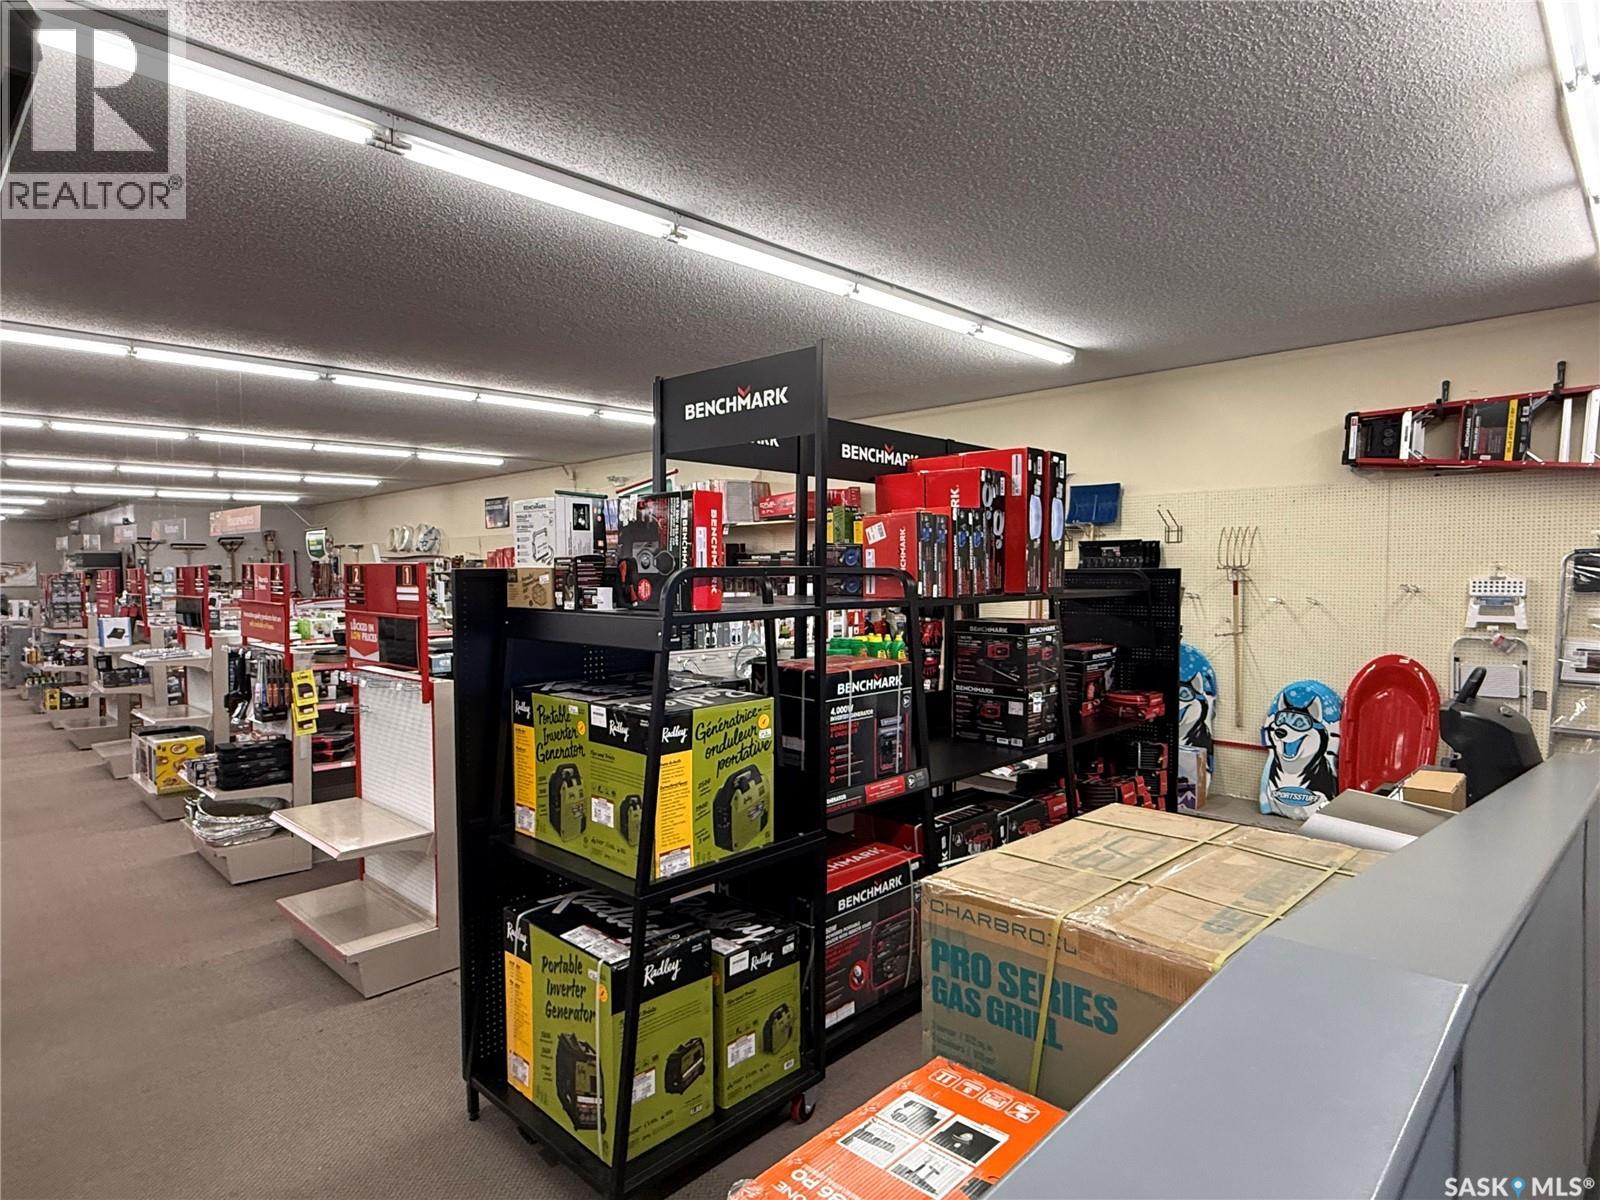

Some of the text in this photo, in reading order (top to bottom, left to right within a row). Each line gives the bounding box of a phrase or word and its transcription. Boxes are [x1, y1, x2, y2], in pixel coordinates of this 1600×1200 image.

[684, 385, 789, 421] BENCHMARK
[841, 443, 919, 467] BENCHMAR
[710, 508, 718, 594] BENCHMRK
[837, 674, 903, 696] BENCHMARK
[514, 699, 531, 720] Radley
[536, 704, 572, 725] Portable
[542, 725, 578, 746] Inverter
[608, 717, 630, 743] Radley
[661, 726, 689, 744] Radley
[704, 724, 758, 760] onduleur
[536, 741, 586, 765] Generator
[716, 738, 773, 778] portative
[837, 874, 903, 912] BENCHMARK
[541, 954, 583, 975] Portable
[643, 957, 682, 988] Radley
[750, 951, 774, 971] Radley
[546, 979, 587, 998] Inverter
[930, 937, 1119, 1036] PRO SERIES
[932, 973, 983, 1019] GAS
[545, 1001, 597, 1024] Generator
